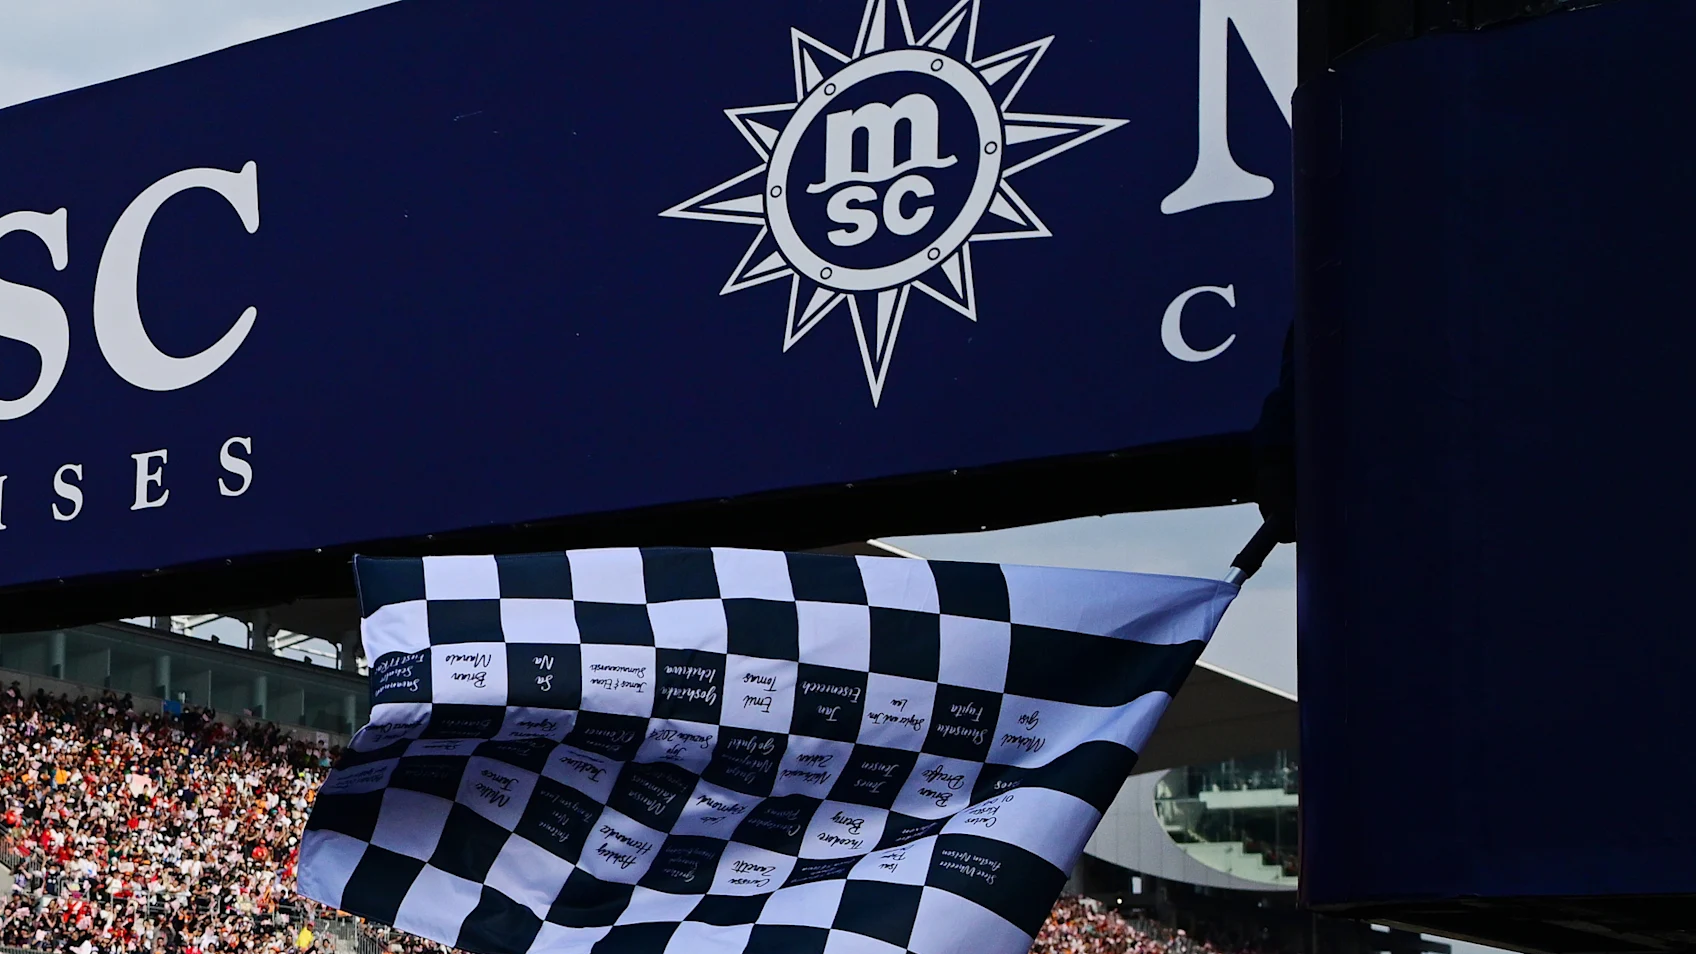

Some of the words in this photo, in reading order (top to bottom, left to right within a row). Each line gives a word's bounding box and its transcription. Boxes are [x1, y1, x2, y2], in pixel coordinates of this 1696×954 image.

[443, 652, 491, 667] Manalo
[449, 670, 487, 688] Brian
[533, 673, 553, 691] Sa
[741, 672, 777, 692] Tomas
[740, 694, 772, 713] Emil
[815, 704, 841, 721] Jan
[948, 701, 983, 721] Fujita
[647, 727, 677, 741] 2024
[935, 722, 986, 745] Shinsaku
[1000, 732, 1046, 752] Michael
[916, 786, 953, 807] Brian
[815, 831, 863, 850] Theodore
